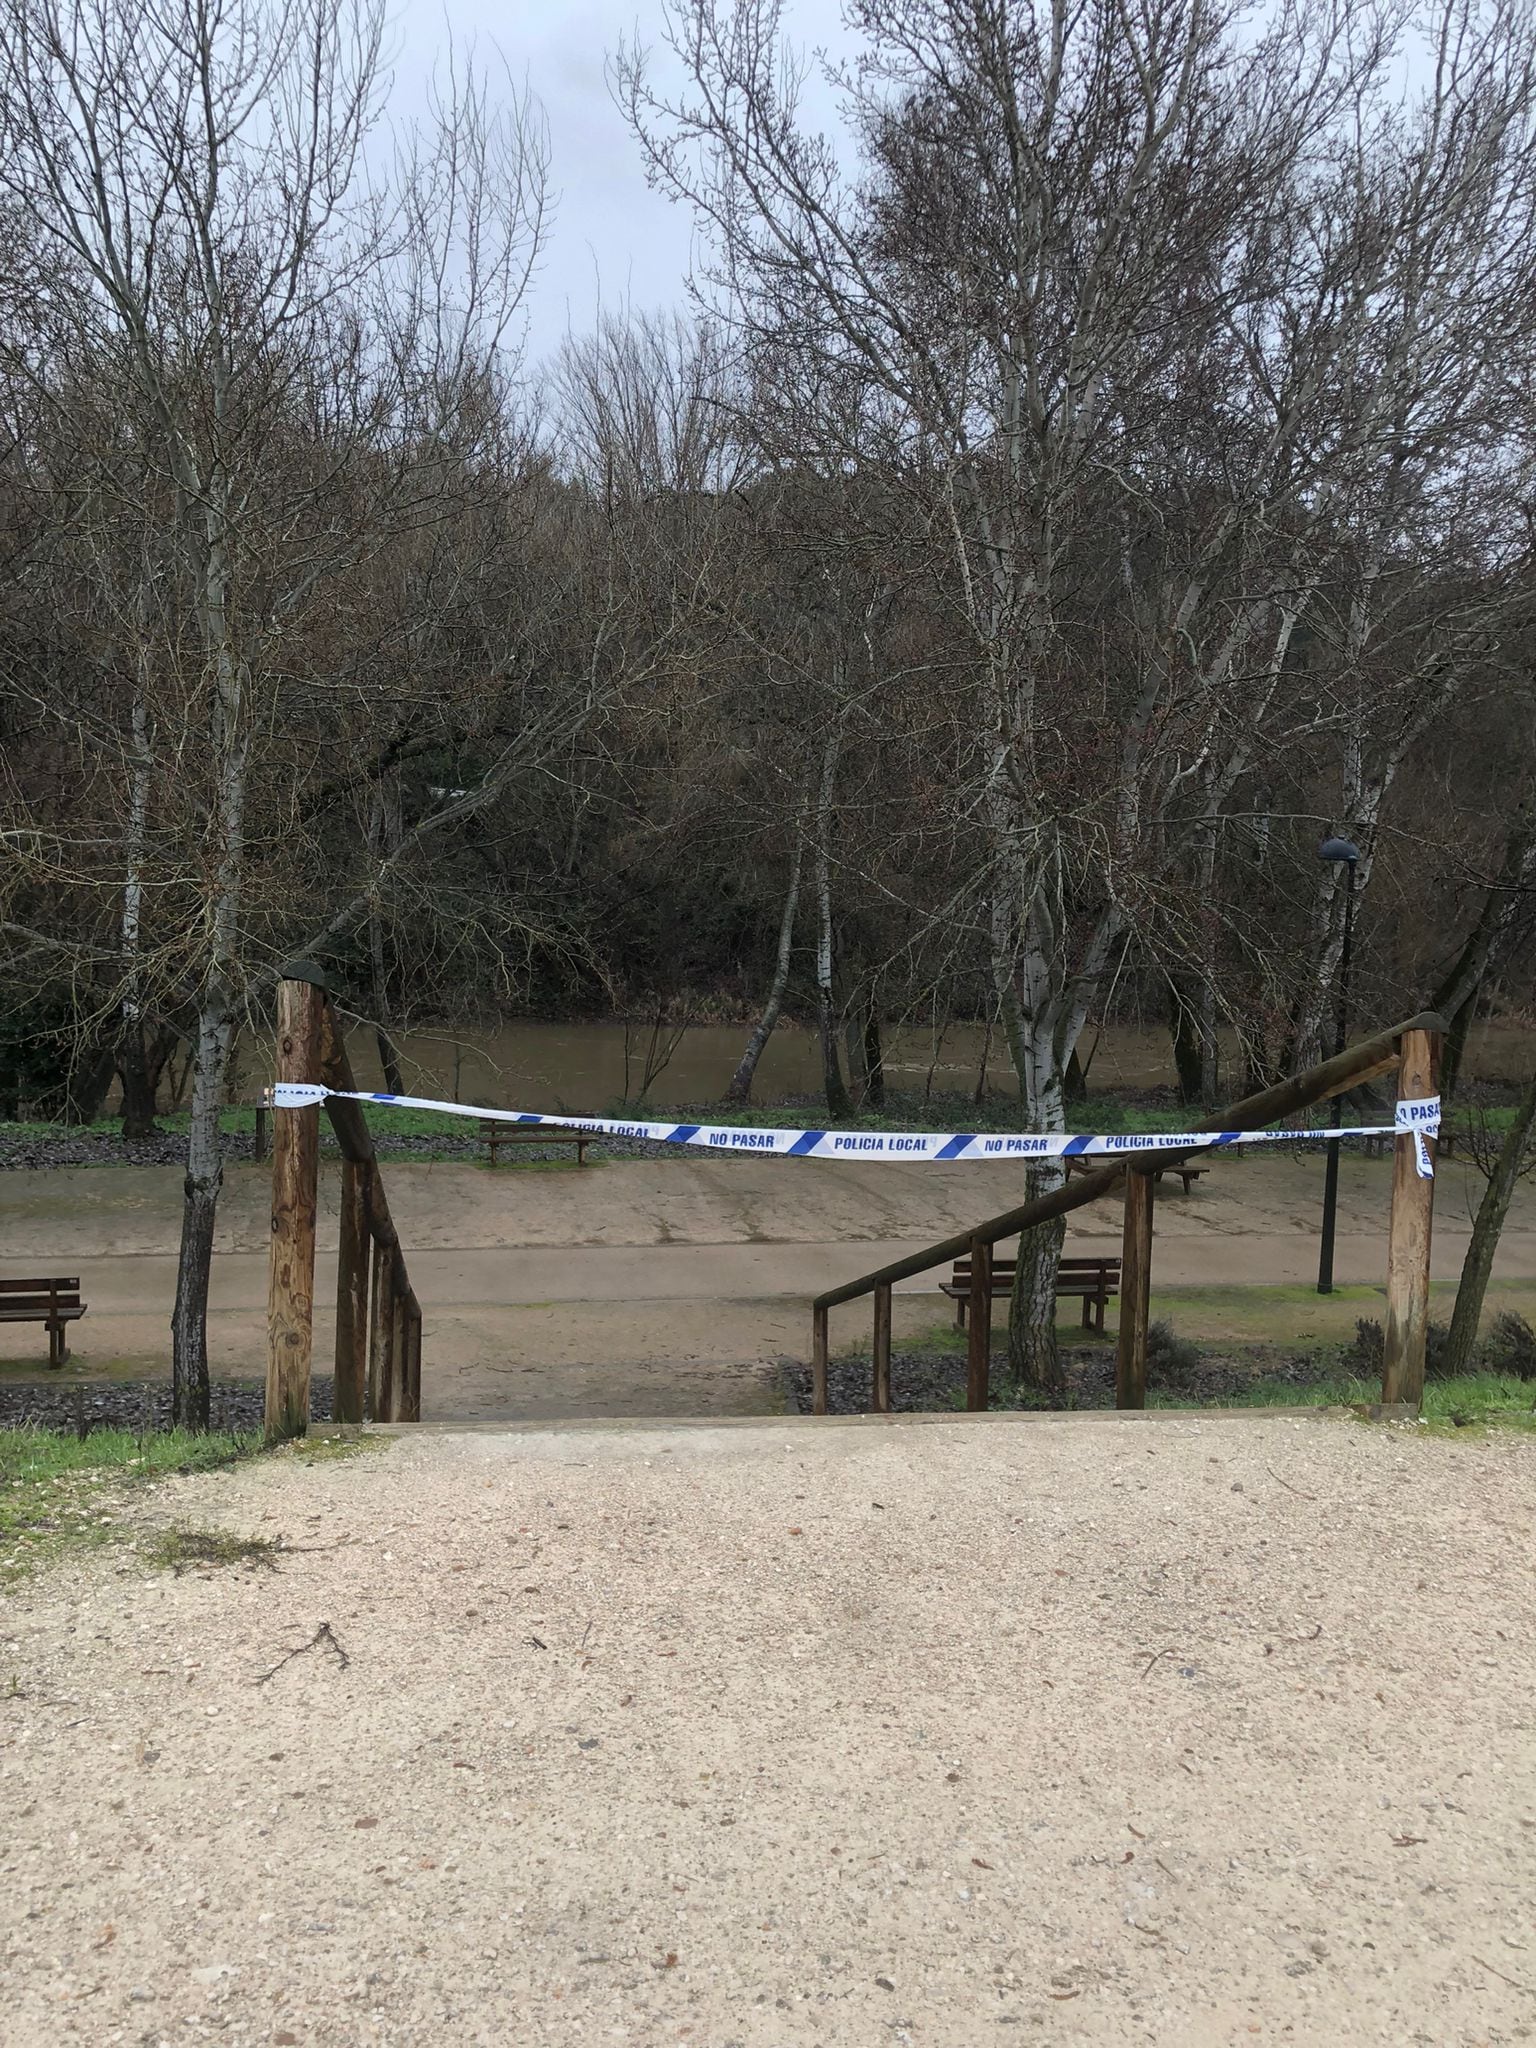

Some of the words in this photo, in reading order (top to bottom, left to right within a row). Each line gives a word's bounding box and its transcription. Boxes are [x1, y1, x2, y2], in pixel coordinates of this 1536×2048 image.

[1411, 1104, 1440, 1120] PASA
[709, 1133, 727, 1145] NO
[732, 1134, 774, 1148] PASAR
[834, 1137, 883, 1150] POLICIA
[888, 1138, 927, 1151] LOCAL
[985, 1139, 1003, 1151] NO
[1007, 1139, 1048, 1151] PASAR
[1106, 1136, 1154, 1148] POLICIA
